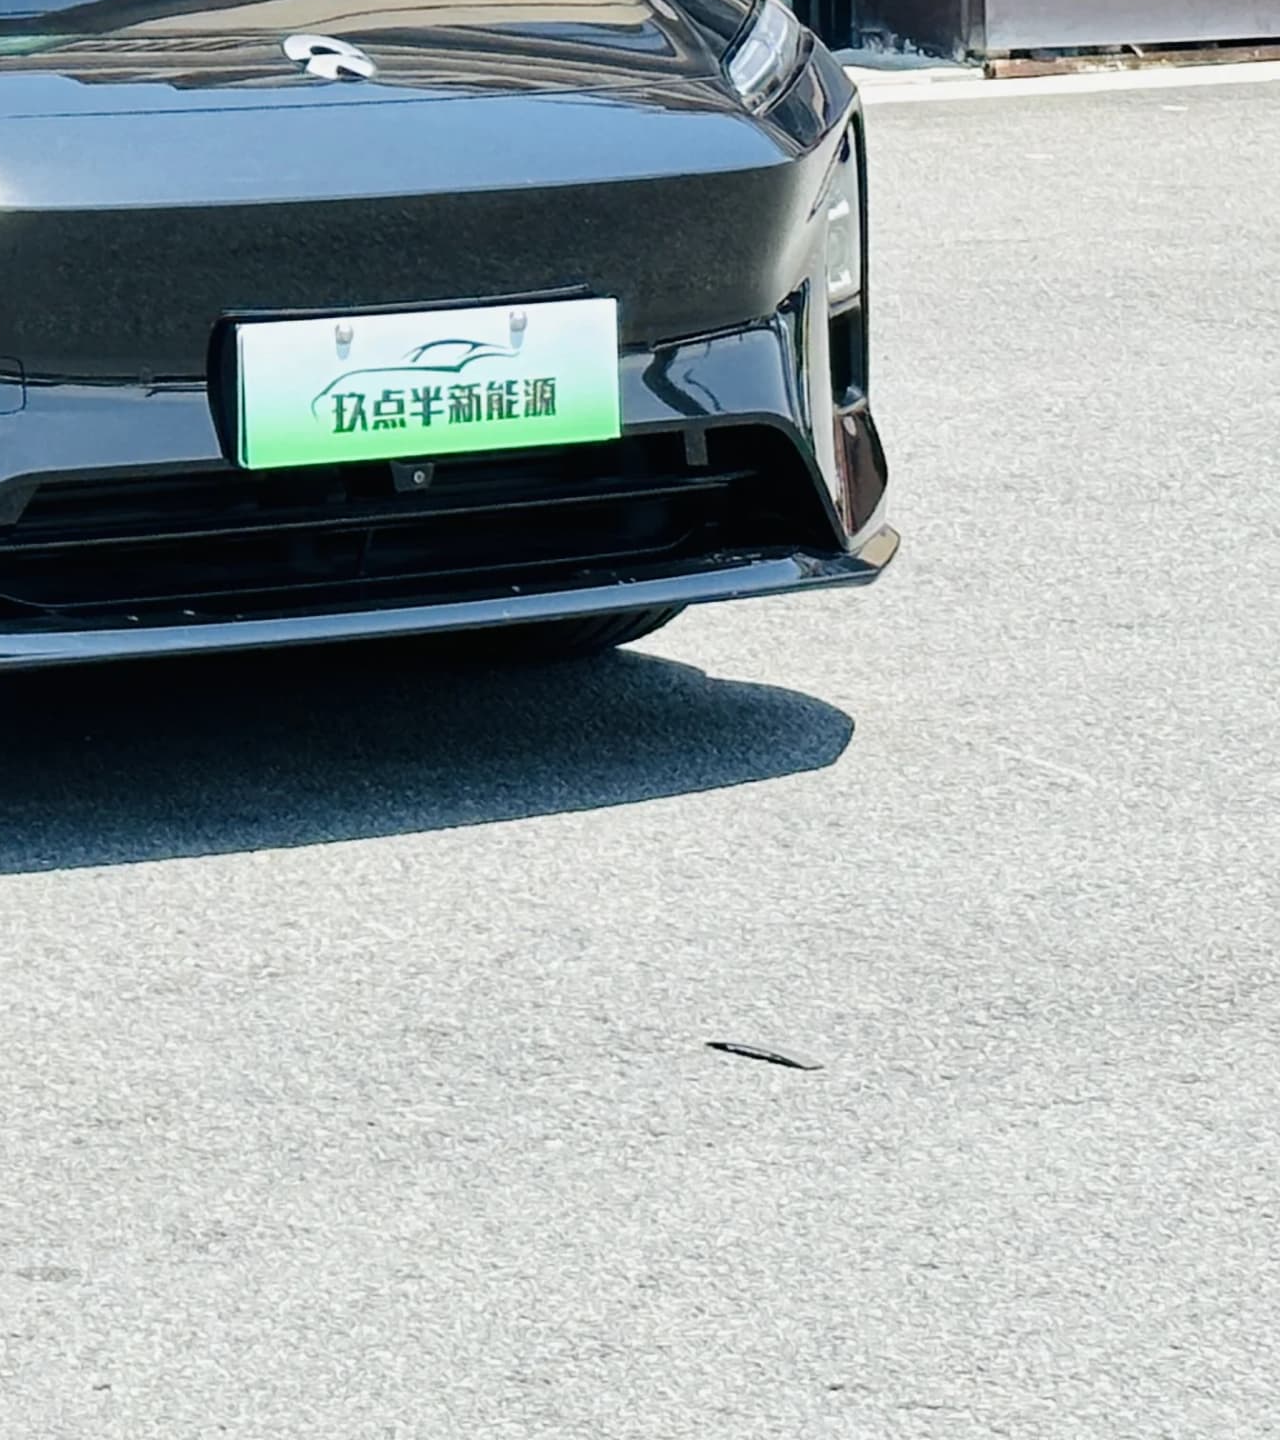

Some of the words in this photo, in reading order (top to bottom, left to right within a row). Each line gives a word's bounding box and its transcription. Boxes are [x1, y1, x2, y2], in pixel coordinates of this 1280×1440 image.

[330, 376, 558, 435] 玖点半新能源
